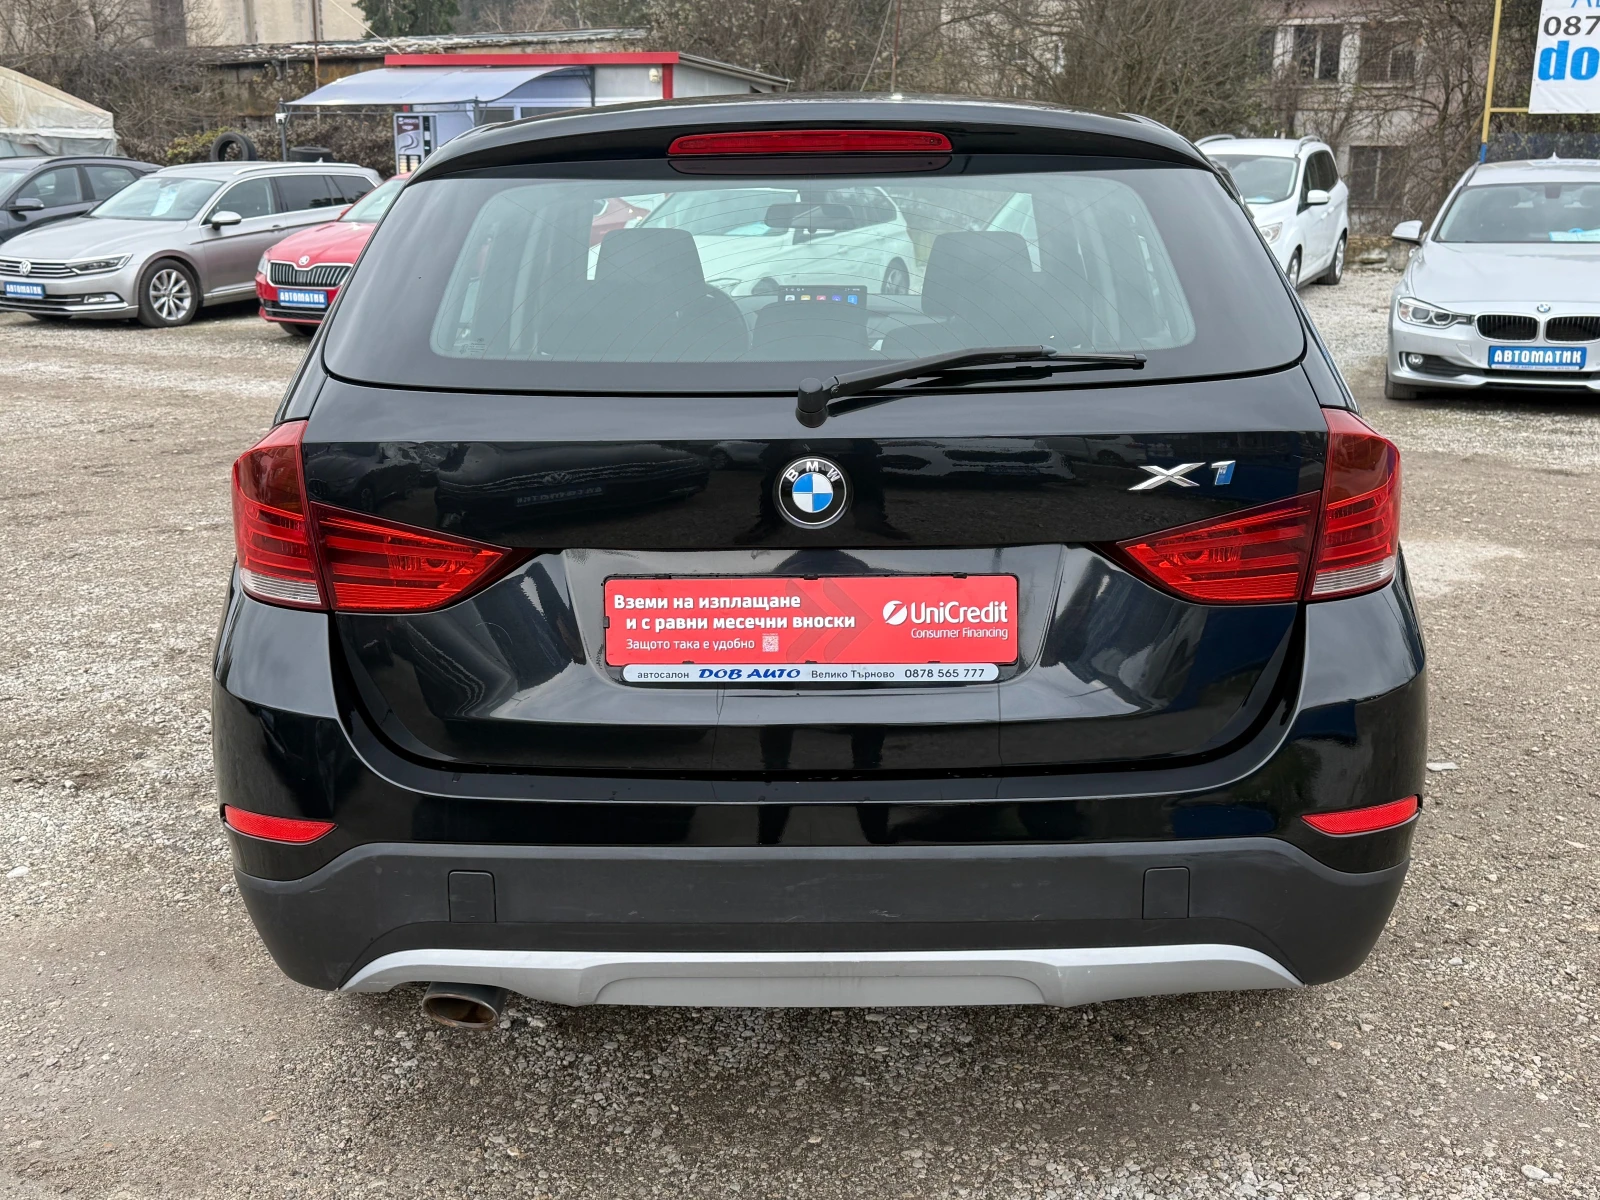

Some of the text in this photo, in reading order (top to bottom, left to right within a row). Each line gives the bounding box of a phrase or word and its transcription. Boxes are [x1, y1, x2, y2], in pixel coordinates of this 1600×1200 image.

[1543, 15, 1600, 36] 087
[1537, 40, 1600, 81] do
[280, 291, 325, 303] АВТОМАТИК
[1494, 350, 1582, 363] АВТОМАТИК
[785, 461, 841, 483] BMW
[1127, 460, 1236, 490] X1
[613, 594, 801, 611] Вземи на изплащане
[910, 601, 1008, 624] UniCredit
[625, 616, 855, 633] и с равни месечни вноски
[911, 627, 1008, 640] Consumer Financing
[626, 638, 755, 651] Защото така е удобно
[637, 671, 690, 679] автосалон
[746, 668, 801, 679] AUTO
[811, 670, 895, 680] Велико Търново
[904, 669, 985, 678] 0878 565 777
